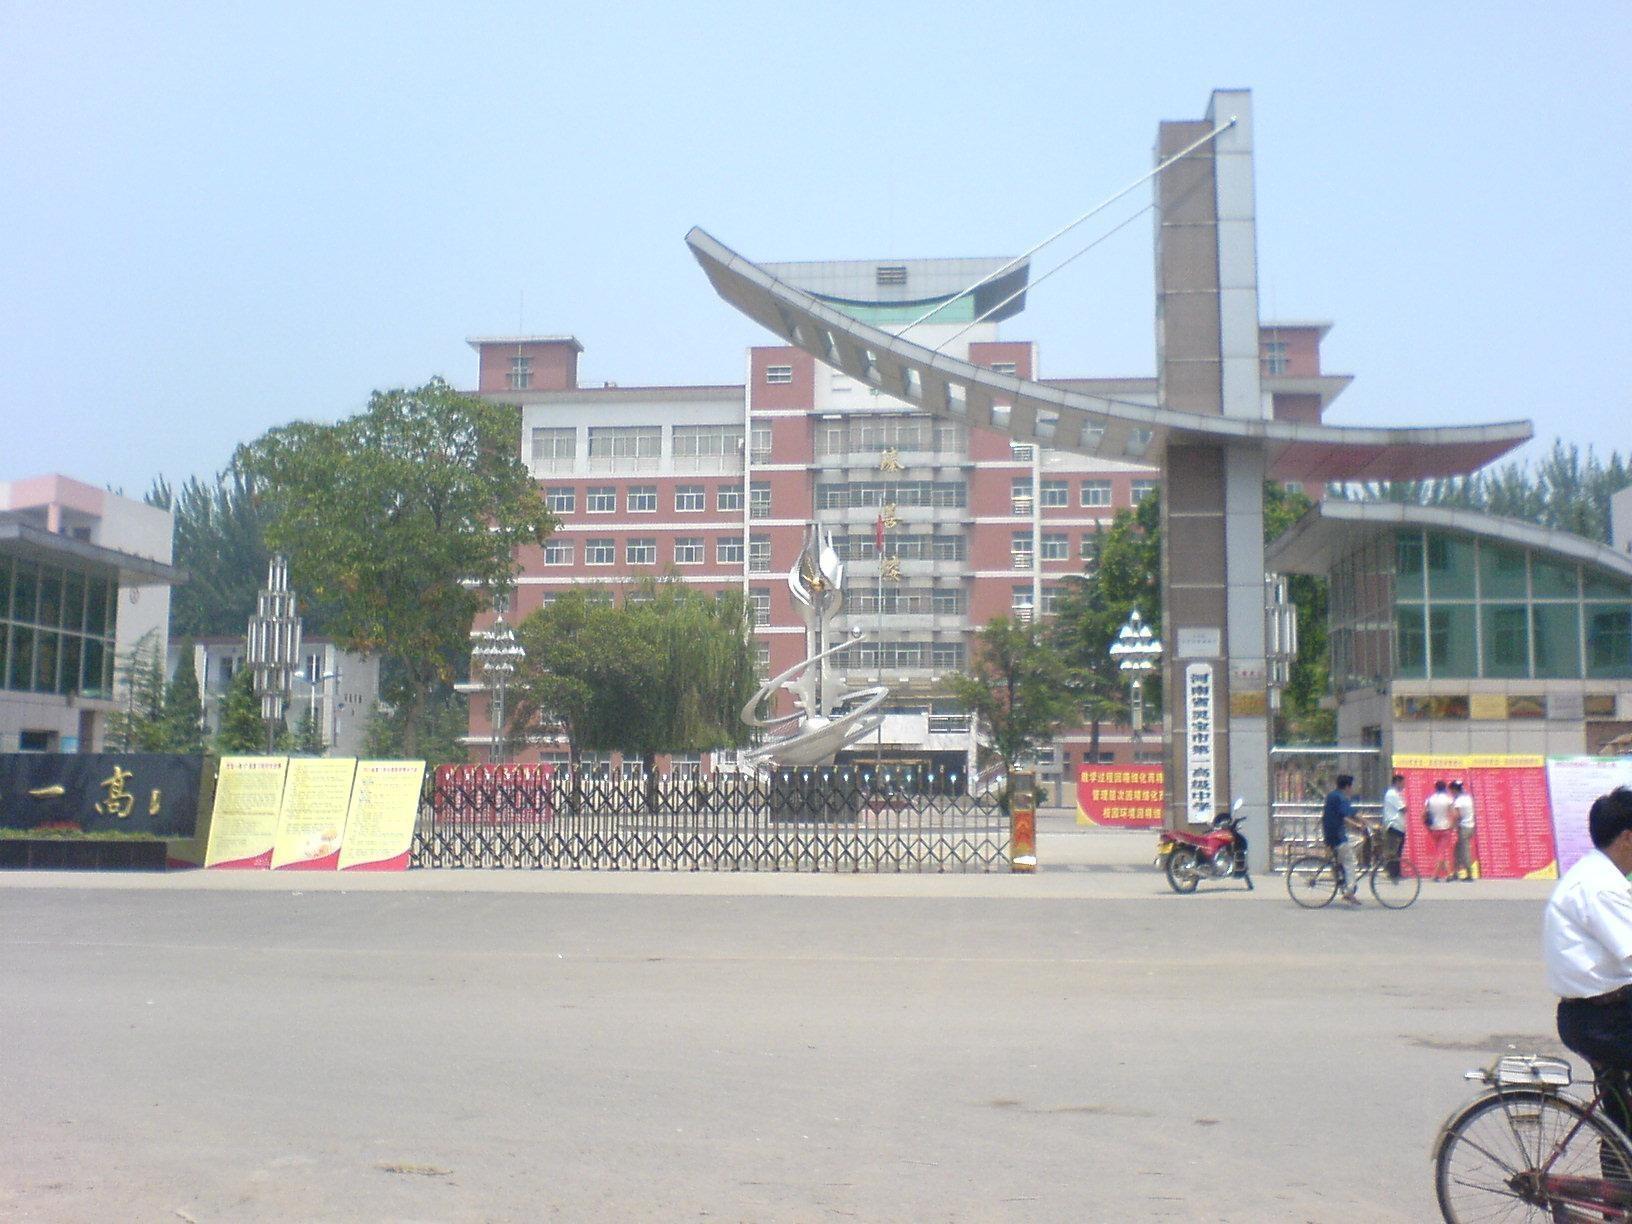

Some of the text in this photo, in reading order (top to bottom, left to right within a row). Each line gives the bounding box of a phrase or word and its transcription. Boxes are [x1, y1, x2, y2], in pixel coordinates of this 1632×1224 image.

[1191, 672, 1211, 812] 河南省灵宝市第一高级中学
